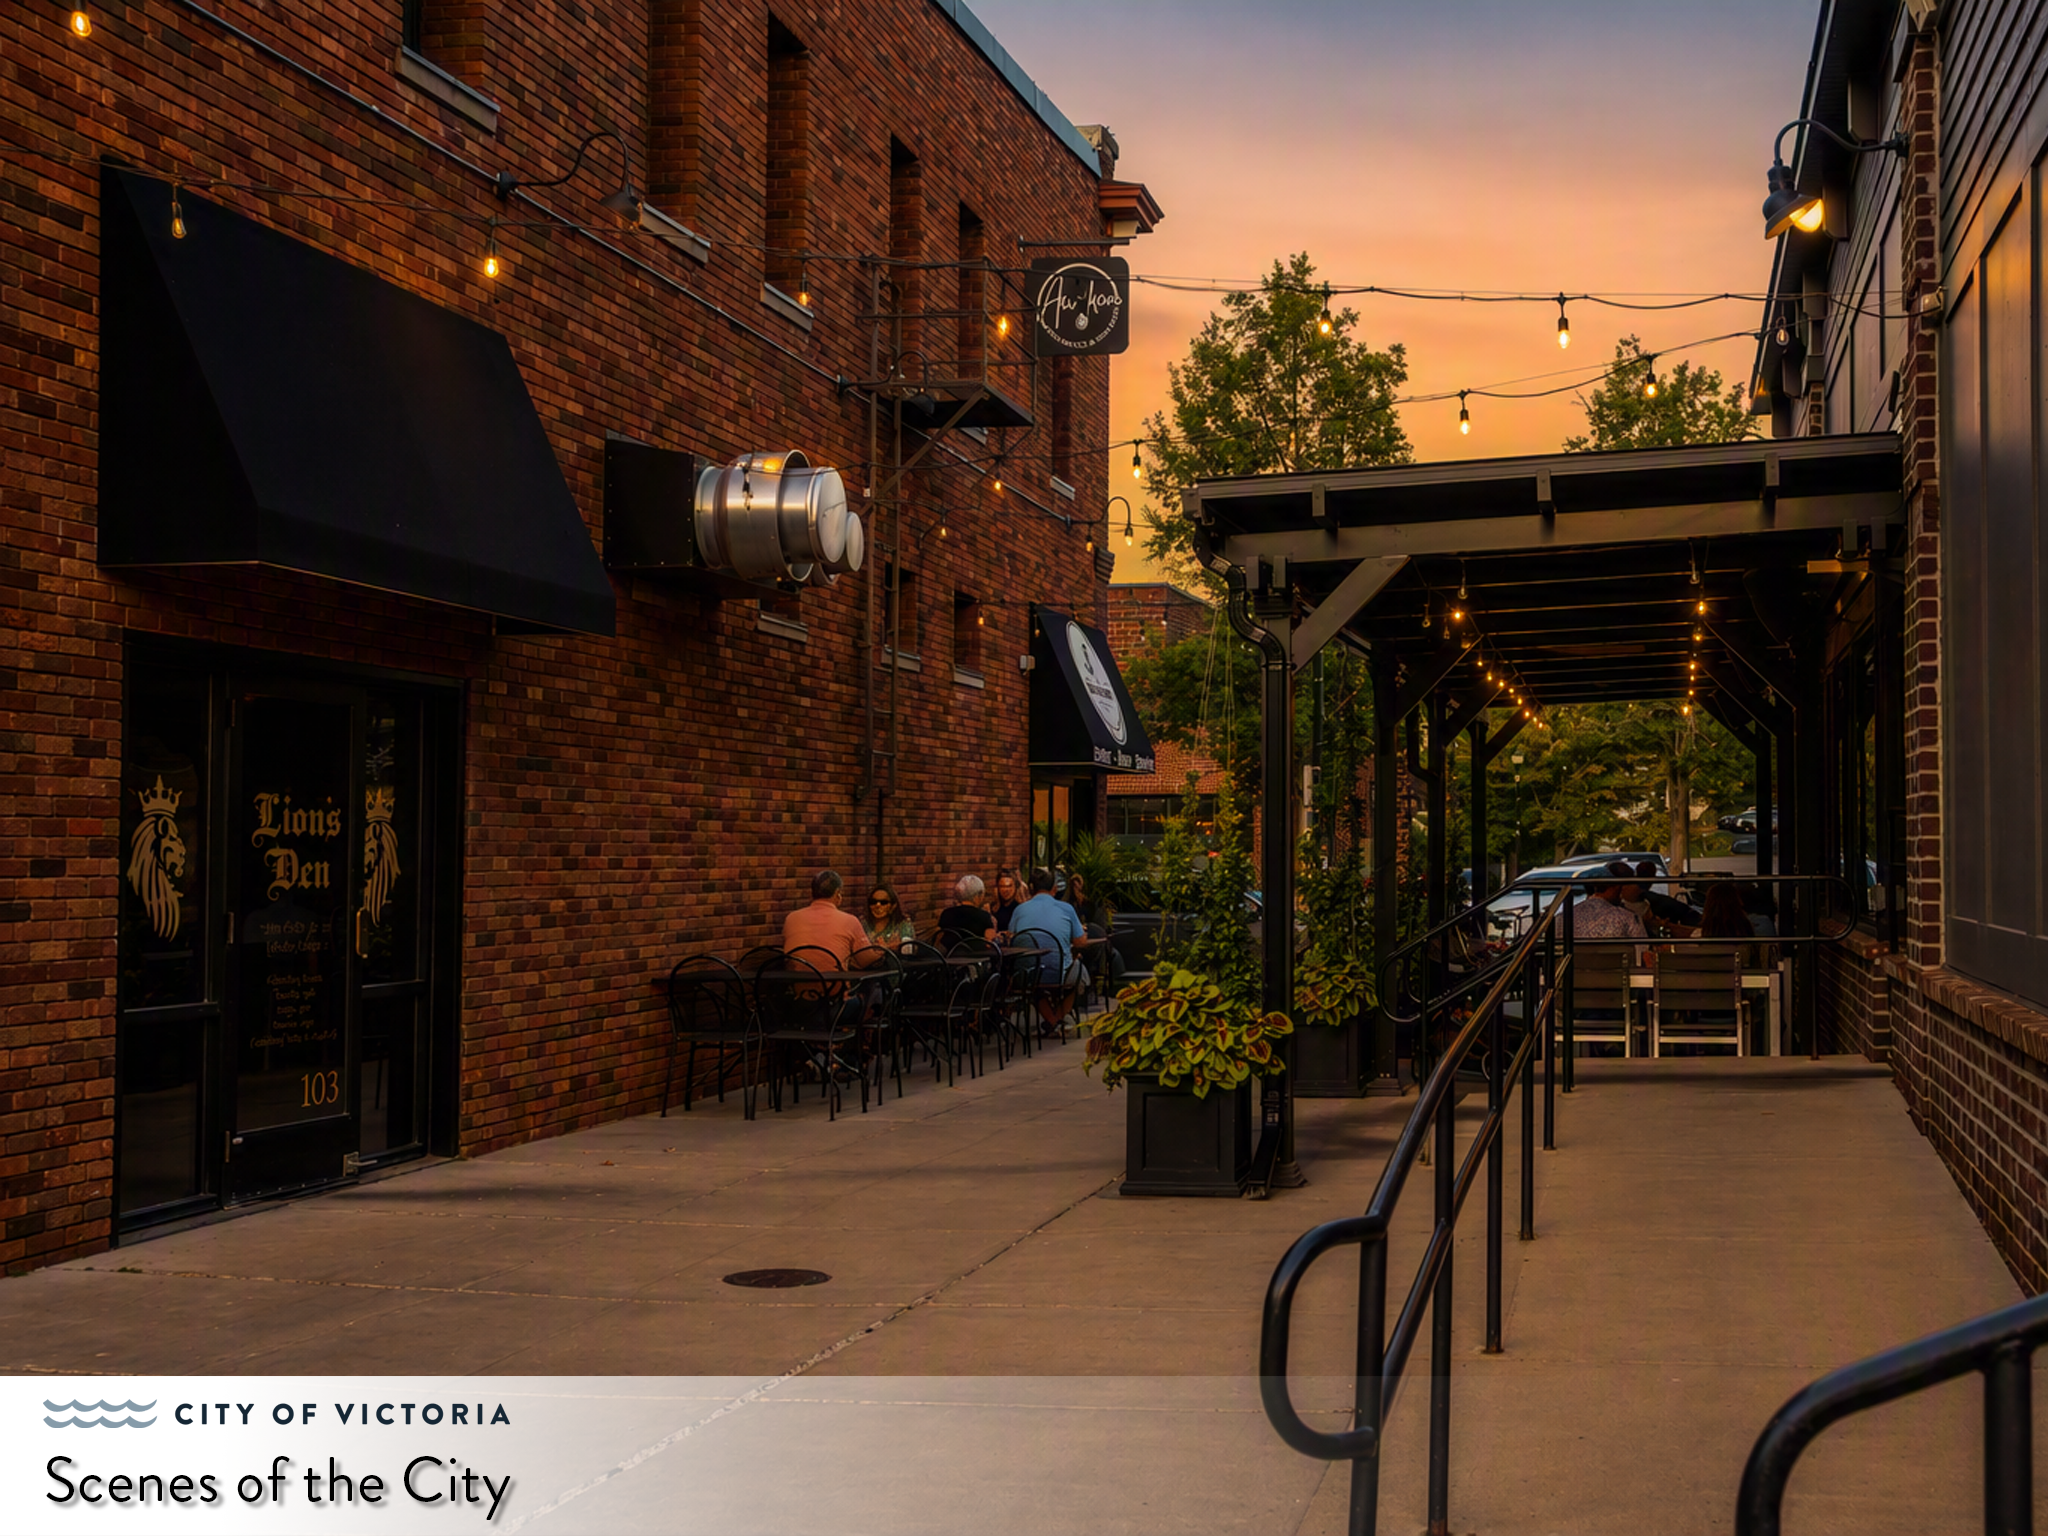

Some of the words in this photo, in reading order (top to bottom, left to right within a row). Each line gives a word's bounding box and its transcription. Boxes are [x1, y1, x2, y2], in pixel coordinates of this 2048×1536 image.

[251, 792, 341, 849] Lion's
[264, 847, 331, 901] Den
[301, 1070, 339, 1108] 103
